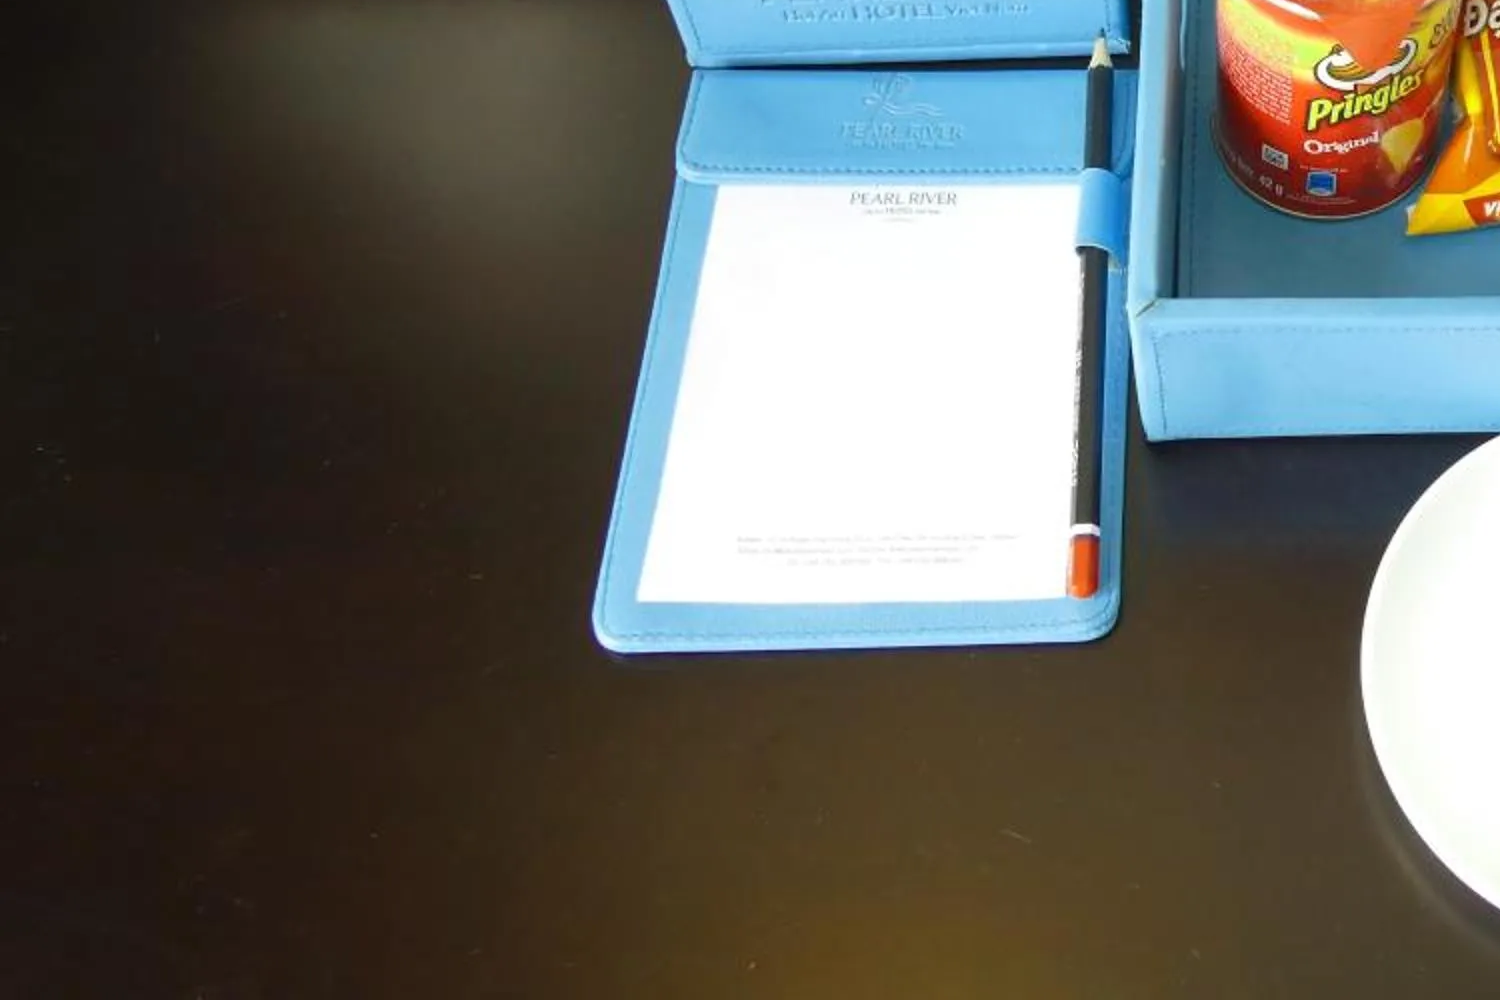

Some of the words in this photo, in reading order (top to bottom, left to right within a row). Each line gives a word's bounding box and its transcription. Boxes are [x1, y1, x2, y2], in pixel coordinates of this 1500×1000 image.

[1306, 67, 1425, 132] Pringles
[1303, 131, 1380, 155] Original
[850, 191, 906, 205] PEARL
[908, 191, 957, 205] RIVER
